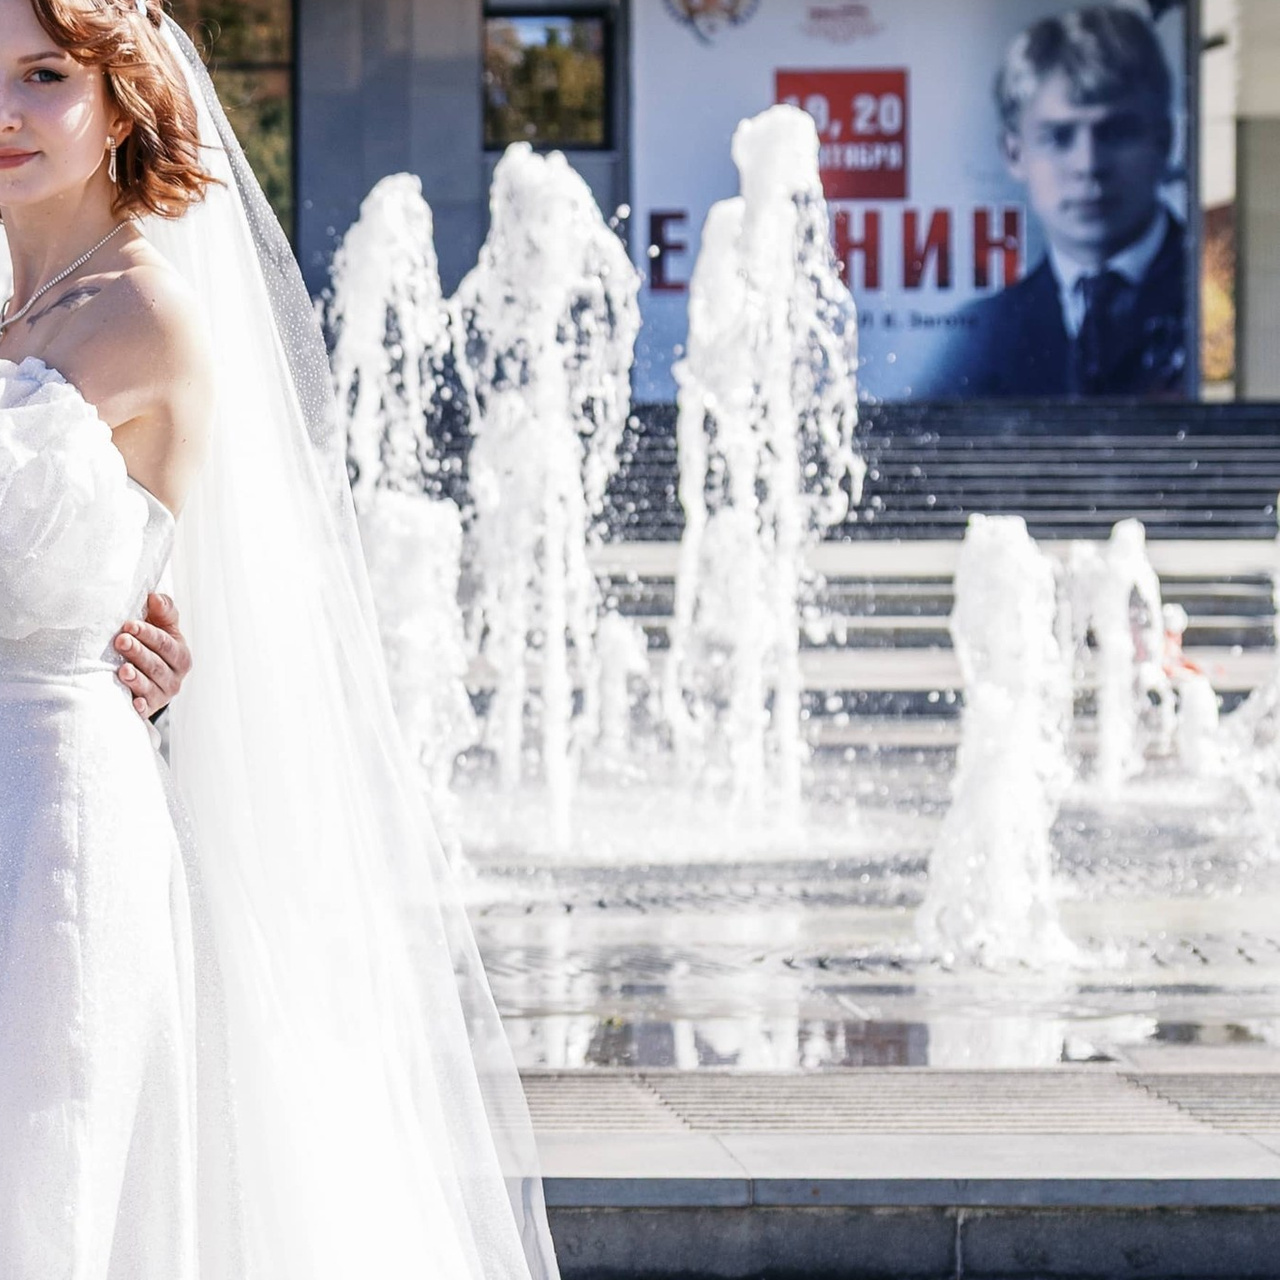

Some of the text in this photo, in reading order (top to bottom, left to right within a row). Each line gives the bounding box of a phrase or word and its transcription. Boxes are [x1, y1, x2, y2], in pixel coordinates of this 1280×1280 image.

[783, 93, 902, 139] 9, 20
[649, 208, 1019, 292] ЕНИН
